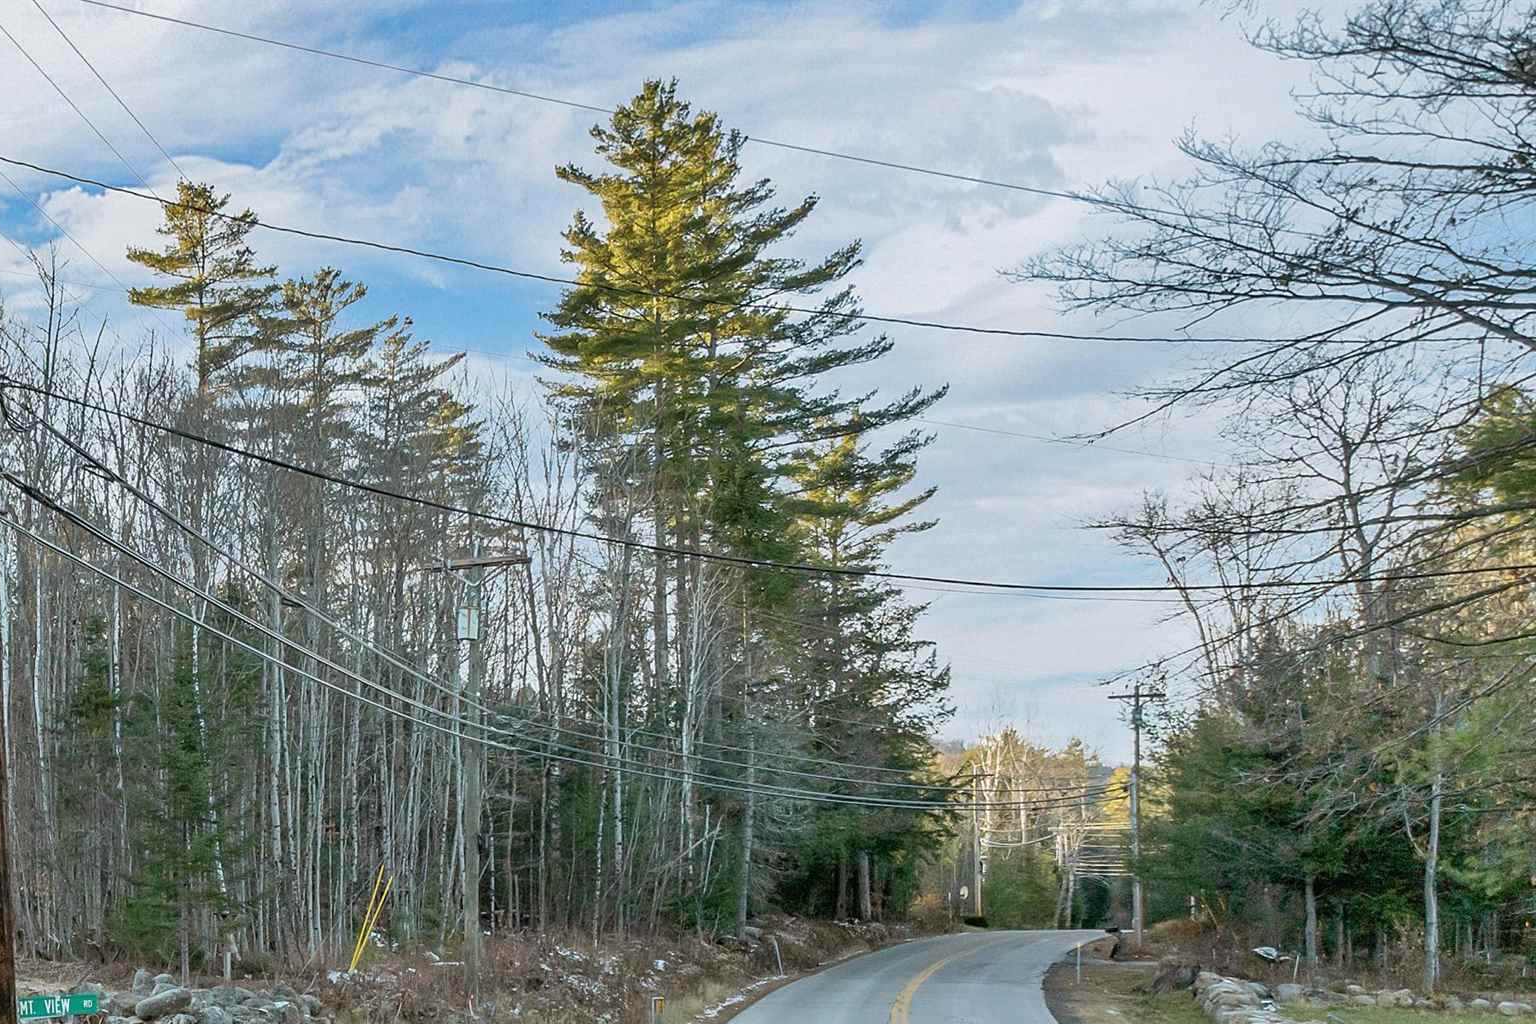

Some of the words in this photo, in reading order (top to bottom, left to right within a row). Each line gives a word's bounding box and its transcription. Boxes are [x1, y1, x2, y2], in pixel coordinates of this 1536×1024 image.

[19, 1000, 37, 1015] MT.
[44, 998, 70, 1015] VIEW
[83, 999, 93, 1008] RD
